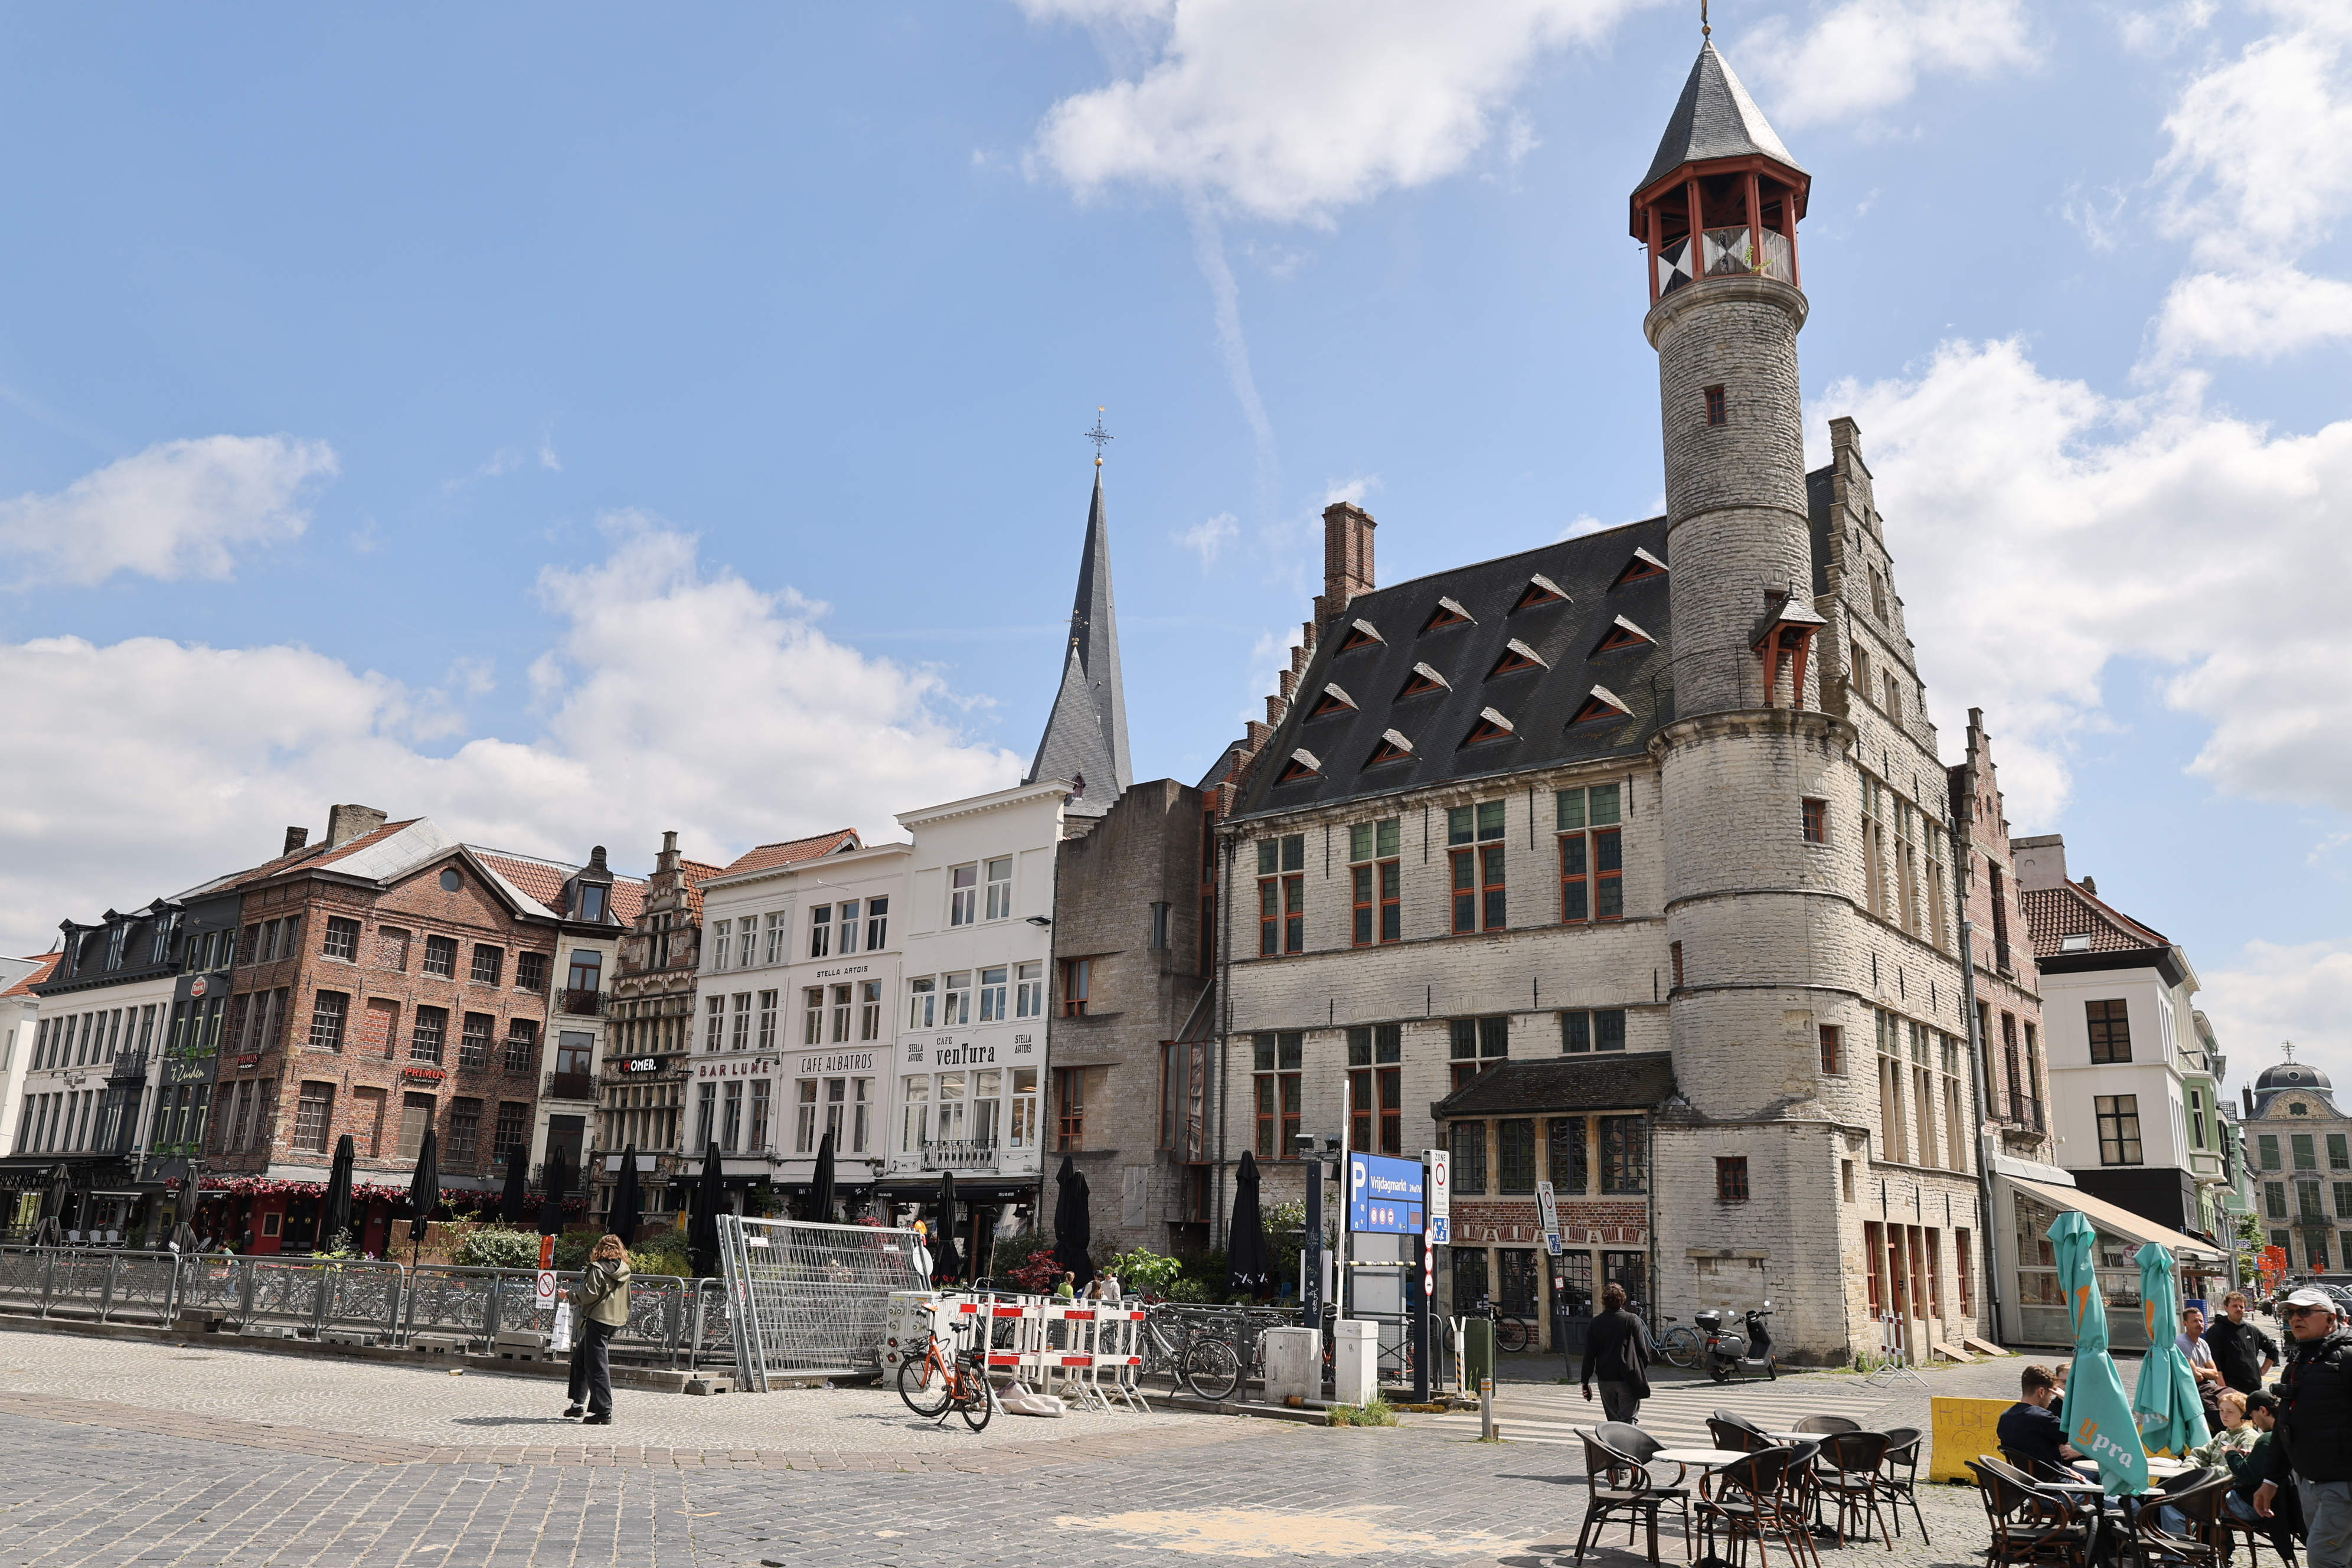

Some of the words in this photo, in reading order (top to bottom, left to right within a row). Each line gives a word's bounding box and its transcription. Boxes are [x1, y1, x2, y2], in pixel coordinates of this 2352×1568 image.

[816, 968, 840, 978] STELLA
[844, 965, 868, 975] ARTOIS
[936, 1036, 952, 1045] CAFE
[1015, 1034, 1031, 1044] STELLA
[908, 1043, 923, 1053] STELLA
[1014, 1044, 1031, 1054] ARTOIS
[237, 1054, 258, 1064] PRIMUS
[802, 1057, 822, 1073] CAFE
[826, 1053, 873, 1072] ALBATROS
[907, 1053, 923, 1062] ARTOIS
[177, 1062, 205, 1082] Zuiden
[405, 1067, 446, 1079] PRIMUS
[700, 1065, 726, 1077] BAR
[732, 1061, 769, 1075] LUME
[1435, 1153, 1446, 1162] ZONE
[1353, 1161, 1366, 1202] P
[1371, 1176, 1407, 1194] Vrijdagmarkt
[1409, 1184, 1422, 1193] 24u/7d
